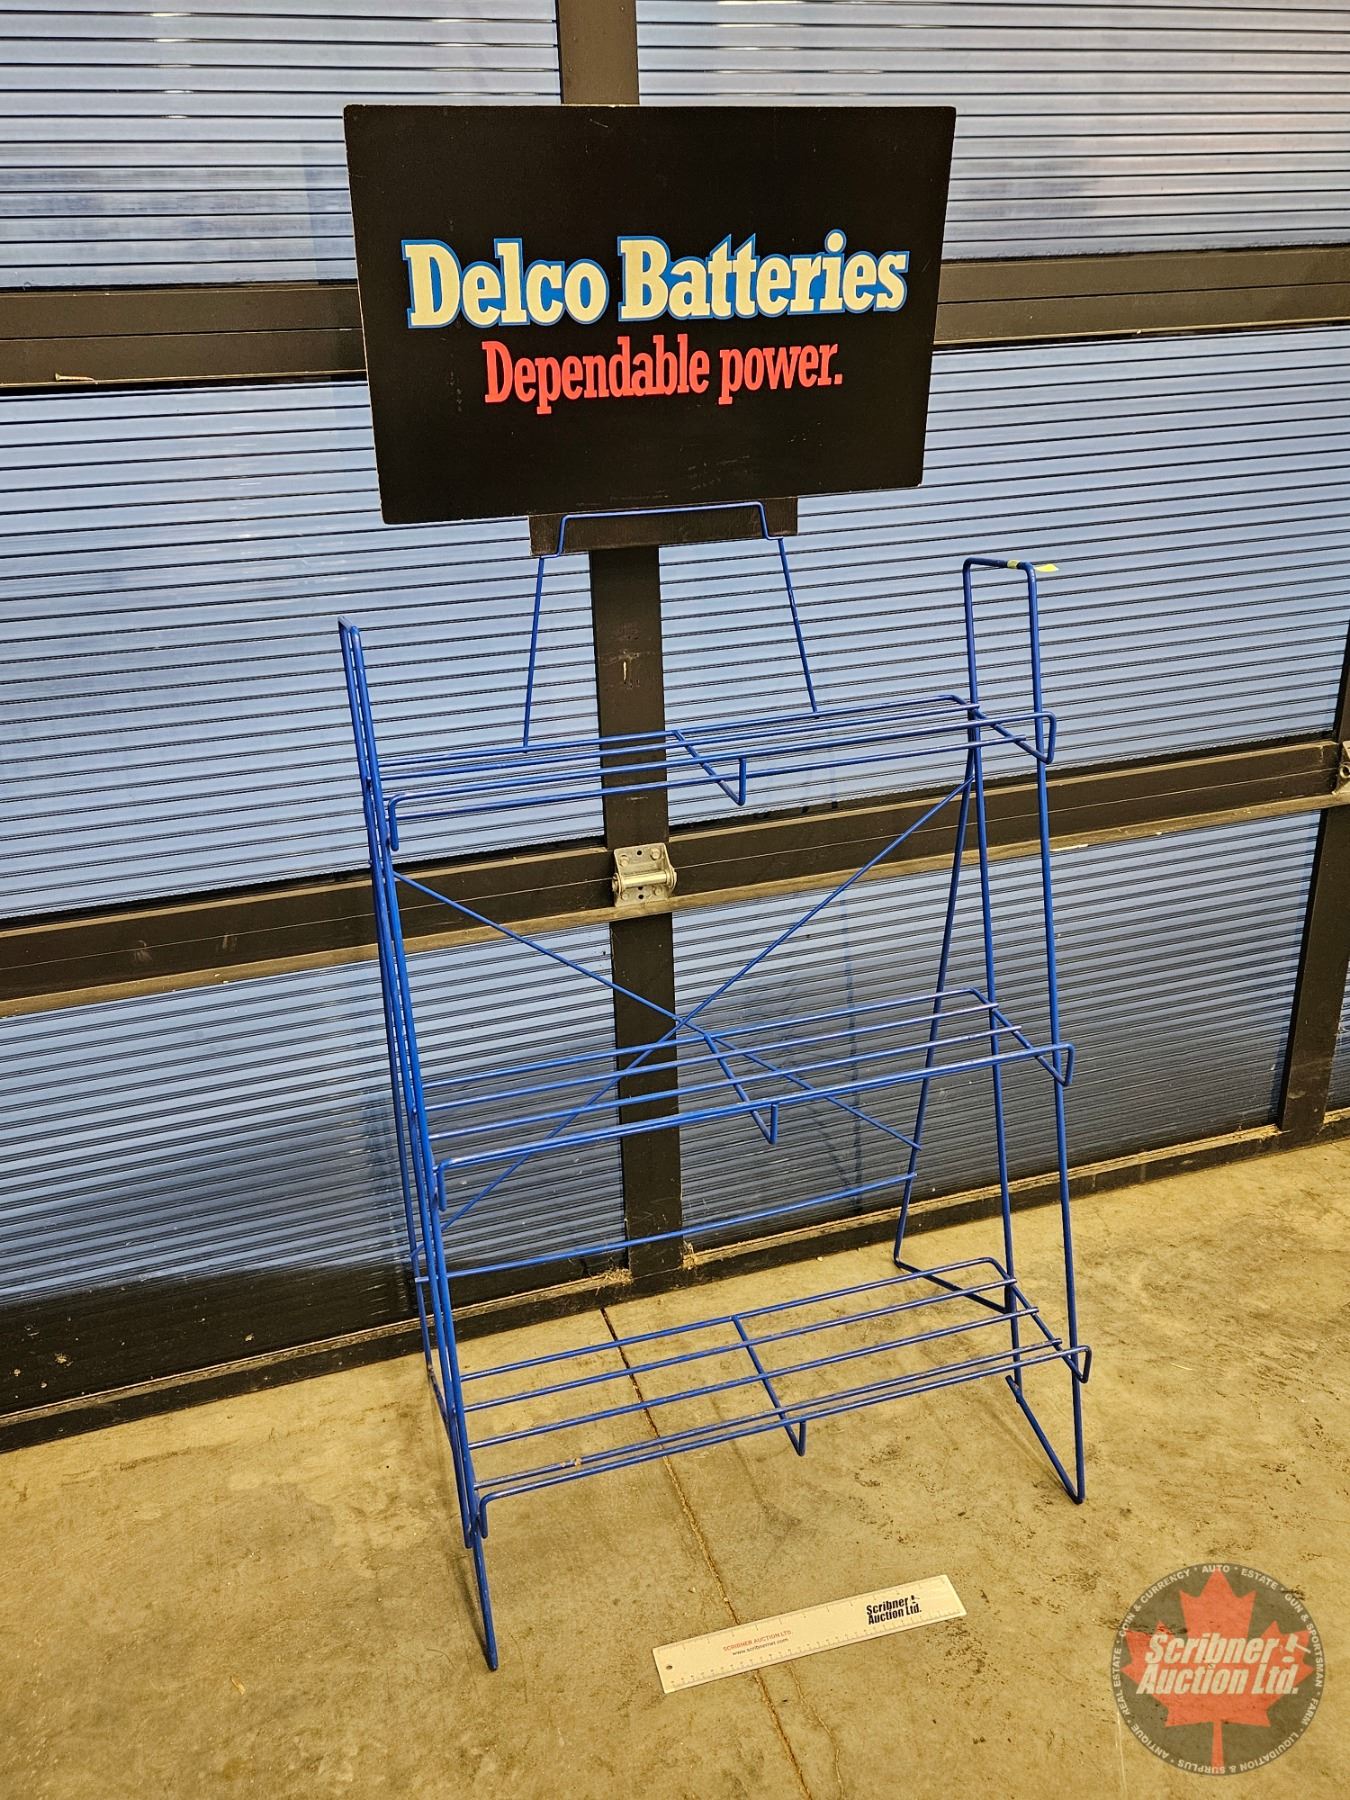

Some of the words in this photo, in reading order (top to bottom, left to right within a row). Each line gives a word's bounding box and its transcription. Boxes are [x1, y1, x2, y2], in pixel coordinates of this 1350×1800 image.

[401, 237, 609, 328] Delco
[617, 229, 909, 321] Batteries
[482, 333, 709, 414] Dependable
[718, 342, 843, 405] power.
[866, 1597, 908, 1615] Scribner
[868, 1608, 904, 1625] Auction
[905, 1603, 922, 1616] Ltd.
